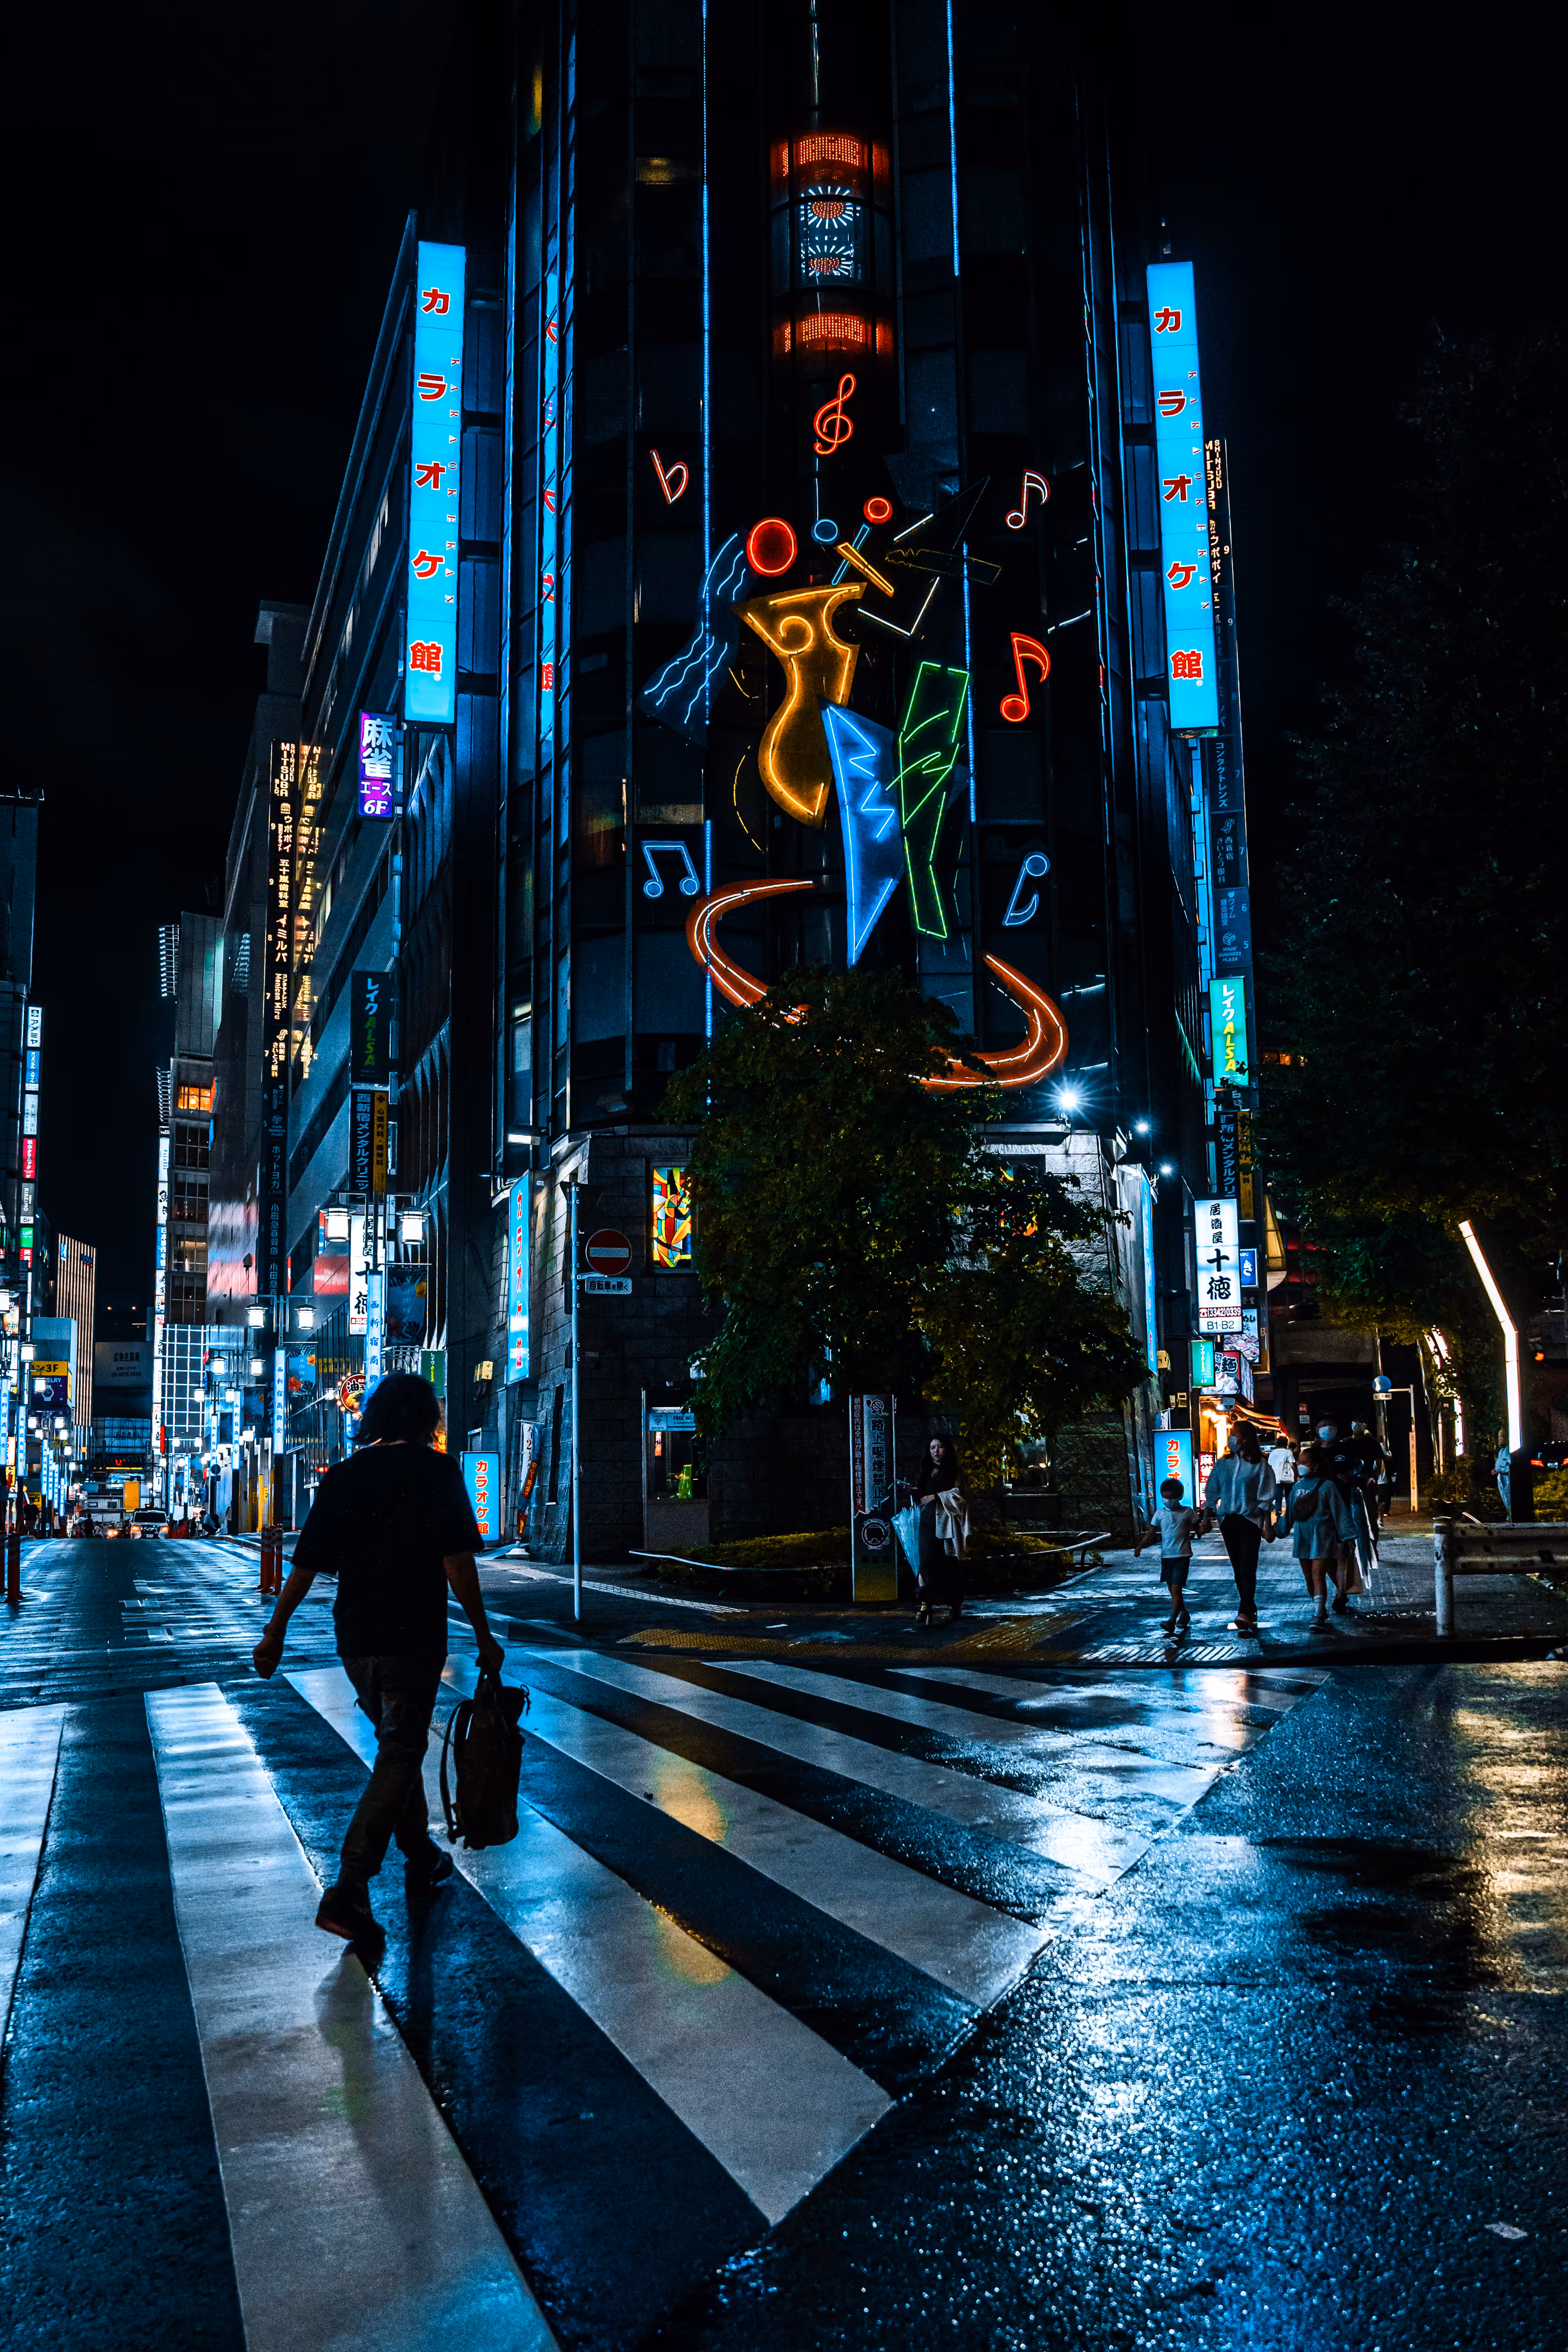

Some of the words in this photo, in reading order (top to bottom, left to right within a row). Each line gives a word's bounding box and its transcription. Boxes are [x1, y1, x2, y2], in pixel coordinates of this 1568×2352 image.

[410, 287, 450, 674] カラオケ館
[1214, 439, 1222, 489] SHINJUKU
[1154, 307, 1203, 680] カラオケ館
[1210, 535, 1221, 583] ウポポイ
[1223, 545, 1230, 554] 9
[280, 743, 290, 797] MITSUBA
[362, 718, 392, 779] 麻雀
[361, 782, 392, 797] エース
[1215, 742, 1228, 808] コンタクトレンズ
[1235, 769, 1240, 778] 7
[364, 800, 386, 815] 6F
[283, 815, 292, 853] ウポポイ
[1225, 836, 1234, 860] 西新宿
[1239, 847, 1244, 855] 7
[279, 859, 289, 908] 五十嵐歯科室
[1217, 837, 1226, 884] さいとう眼科
[275, 929, 289, 962] ミルバ
[1243, 940, 1249, 949] 5
[365, 977, 379, 1066] レイクALSA
[356, 1094, 371, 1198] 西新宿メンタルクリニッ
[270, 1203, 279, 1255] 小田急百貨店
[1210, 1203, 1223, 1243] 居酒屋
[589, 1281, 628, 1292] 自転車を除く
[1207, 1249, 1231, 1300] 十徳
[1207, 1306, 1241, 1318] (3342)0339
[370, 1299, 380, 1386] 西新宿商興
[346, 1379, 365, 1393] 油そ
[1166, 1439, 1181, 1479] カラオ
[475, 1460, 489, 1535] カラオケ館
